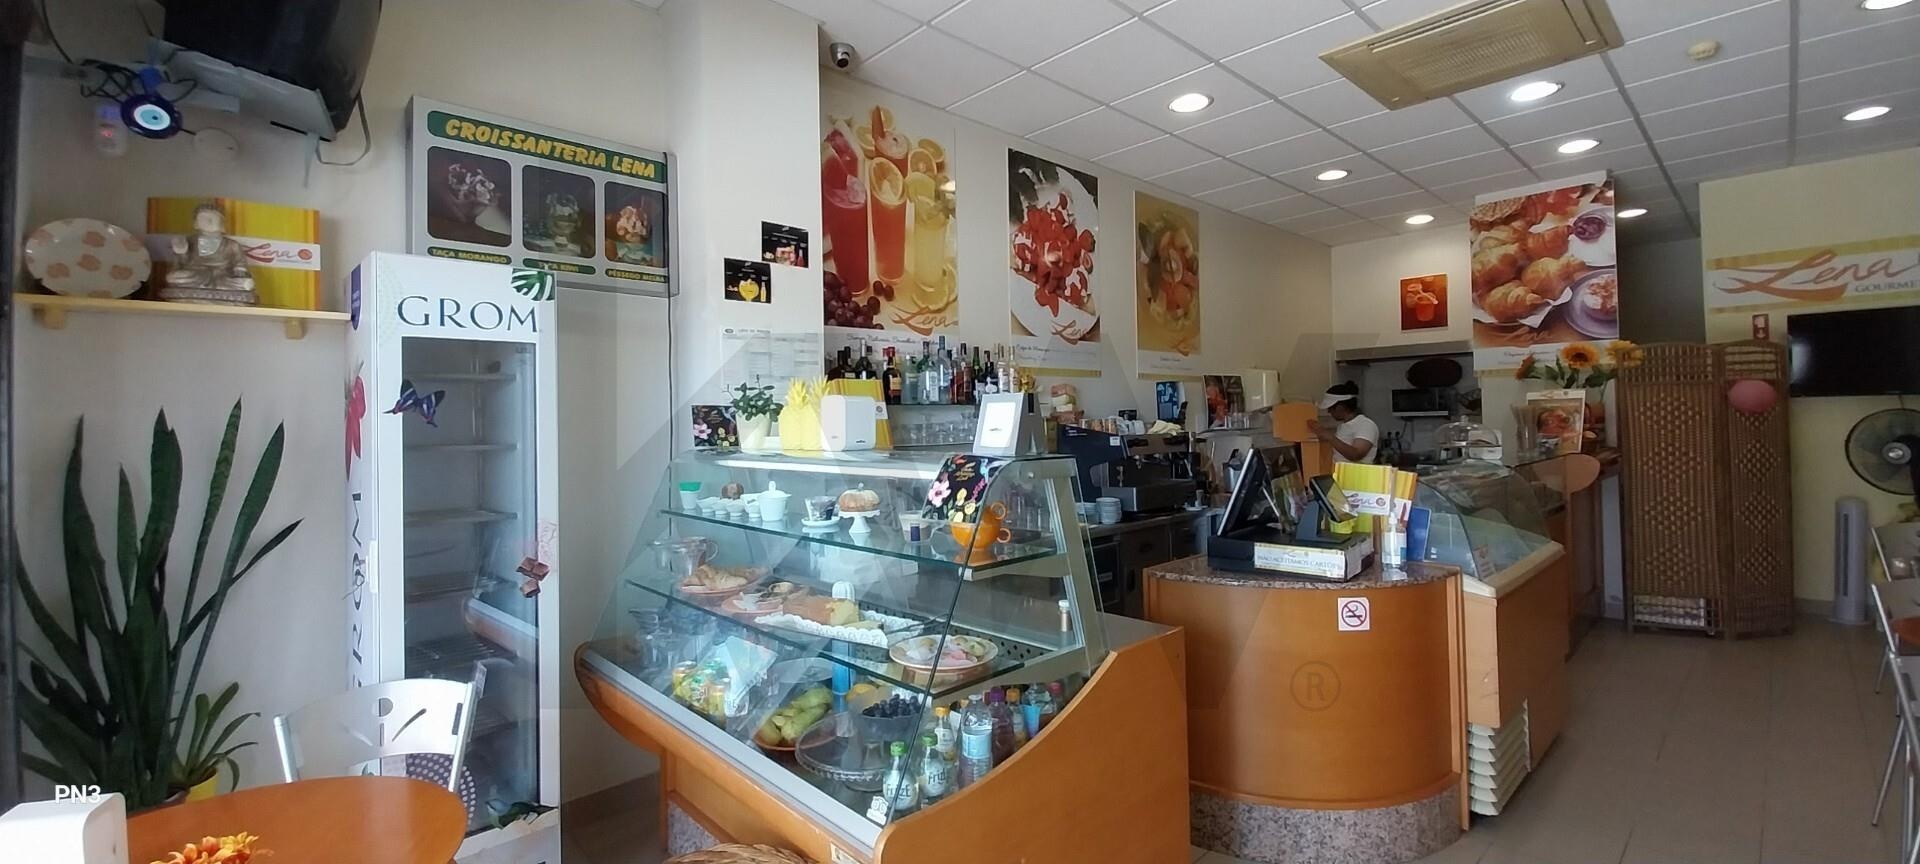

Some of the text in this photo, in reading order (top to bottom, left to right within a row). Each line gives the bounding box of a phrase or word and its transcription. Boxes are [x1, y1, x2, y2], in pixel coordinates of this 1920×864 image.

[446, 119, 655, 178] CROISSANTERIA LENA
[458, 252, 507, 264] MORANGO
[1713, 249, 1914, 301] Lena
[397, 295, 537, 333] GROM
